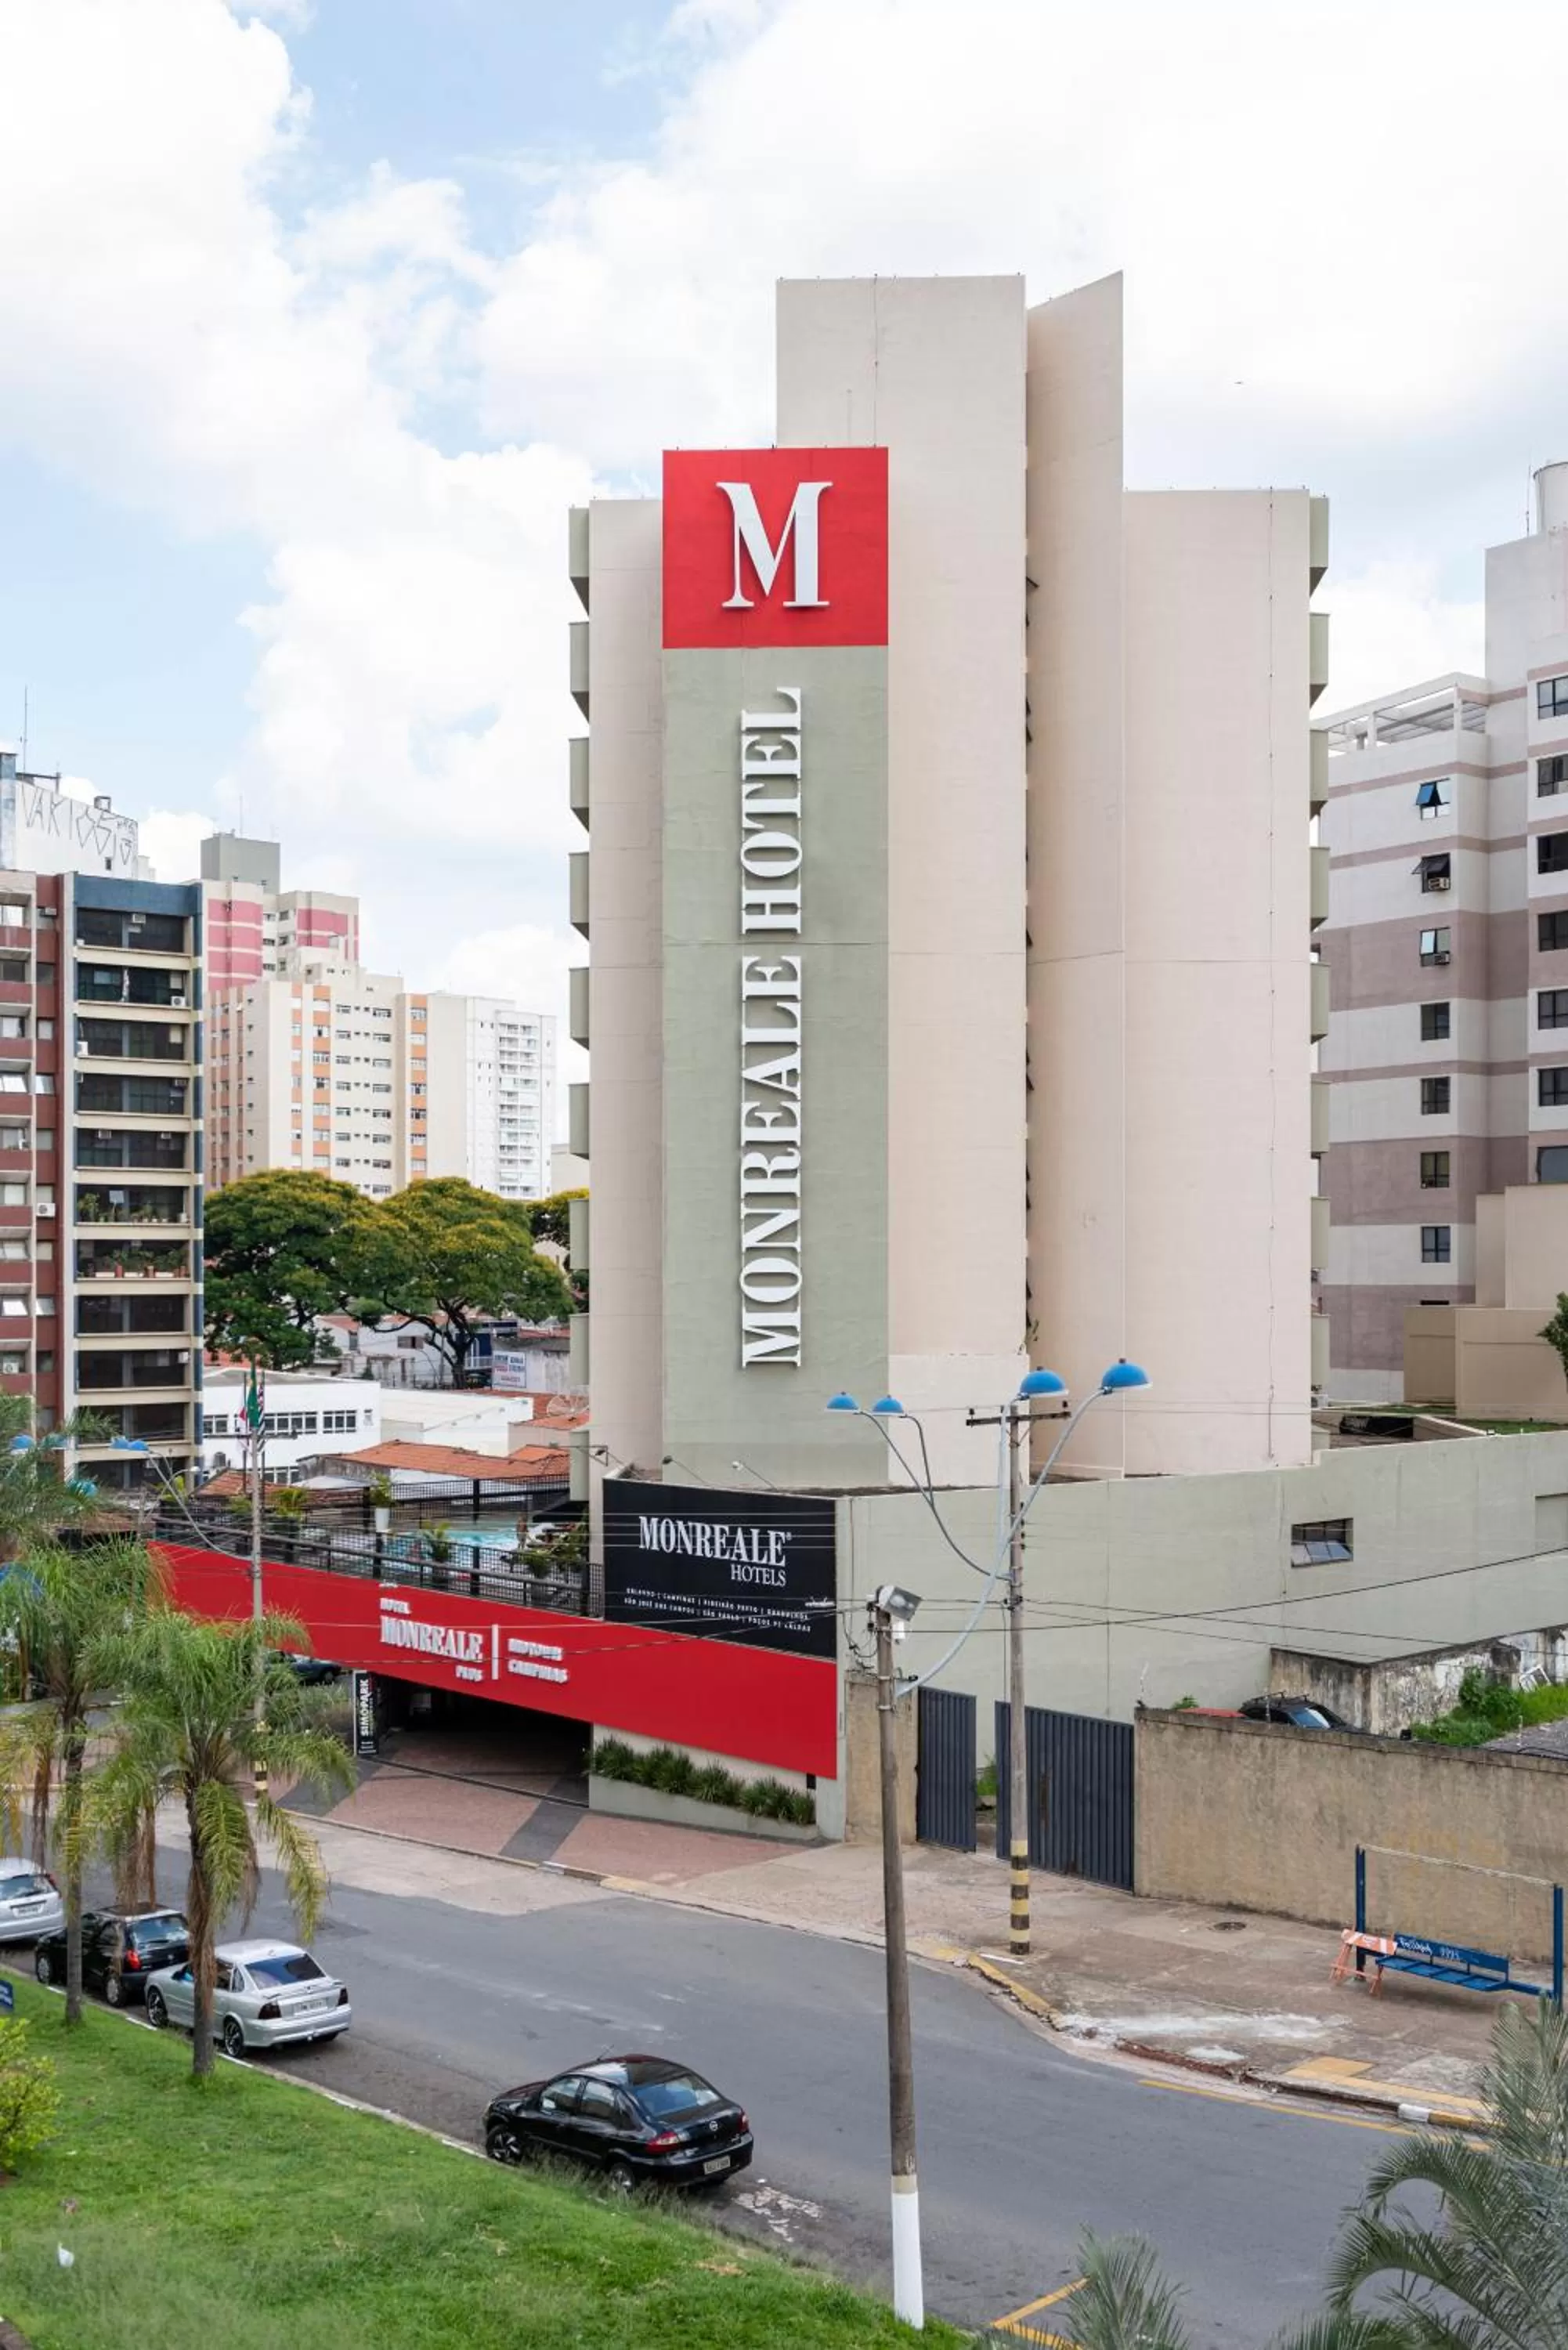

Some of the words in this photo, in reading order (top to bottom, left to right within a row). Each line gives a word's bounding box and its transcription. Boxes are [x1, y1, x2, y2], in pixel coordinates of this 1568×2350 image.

[716, 481, 833, 608] M
[740, 686, 803, 935] HOTEL
[739, 955, 803, 1367] MONREALE
[638, 1516, 786, 1567] MONREALE
[730, 1564, 786, 1586] HOTELS
[380, 1615, 483, 1663] MONREALE
